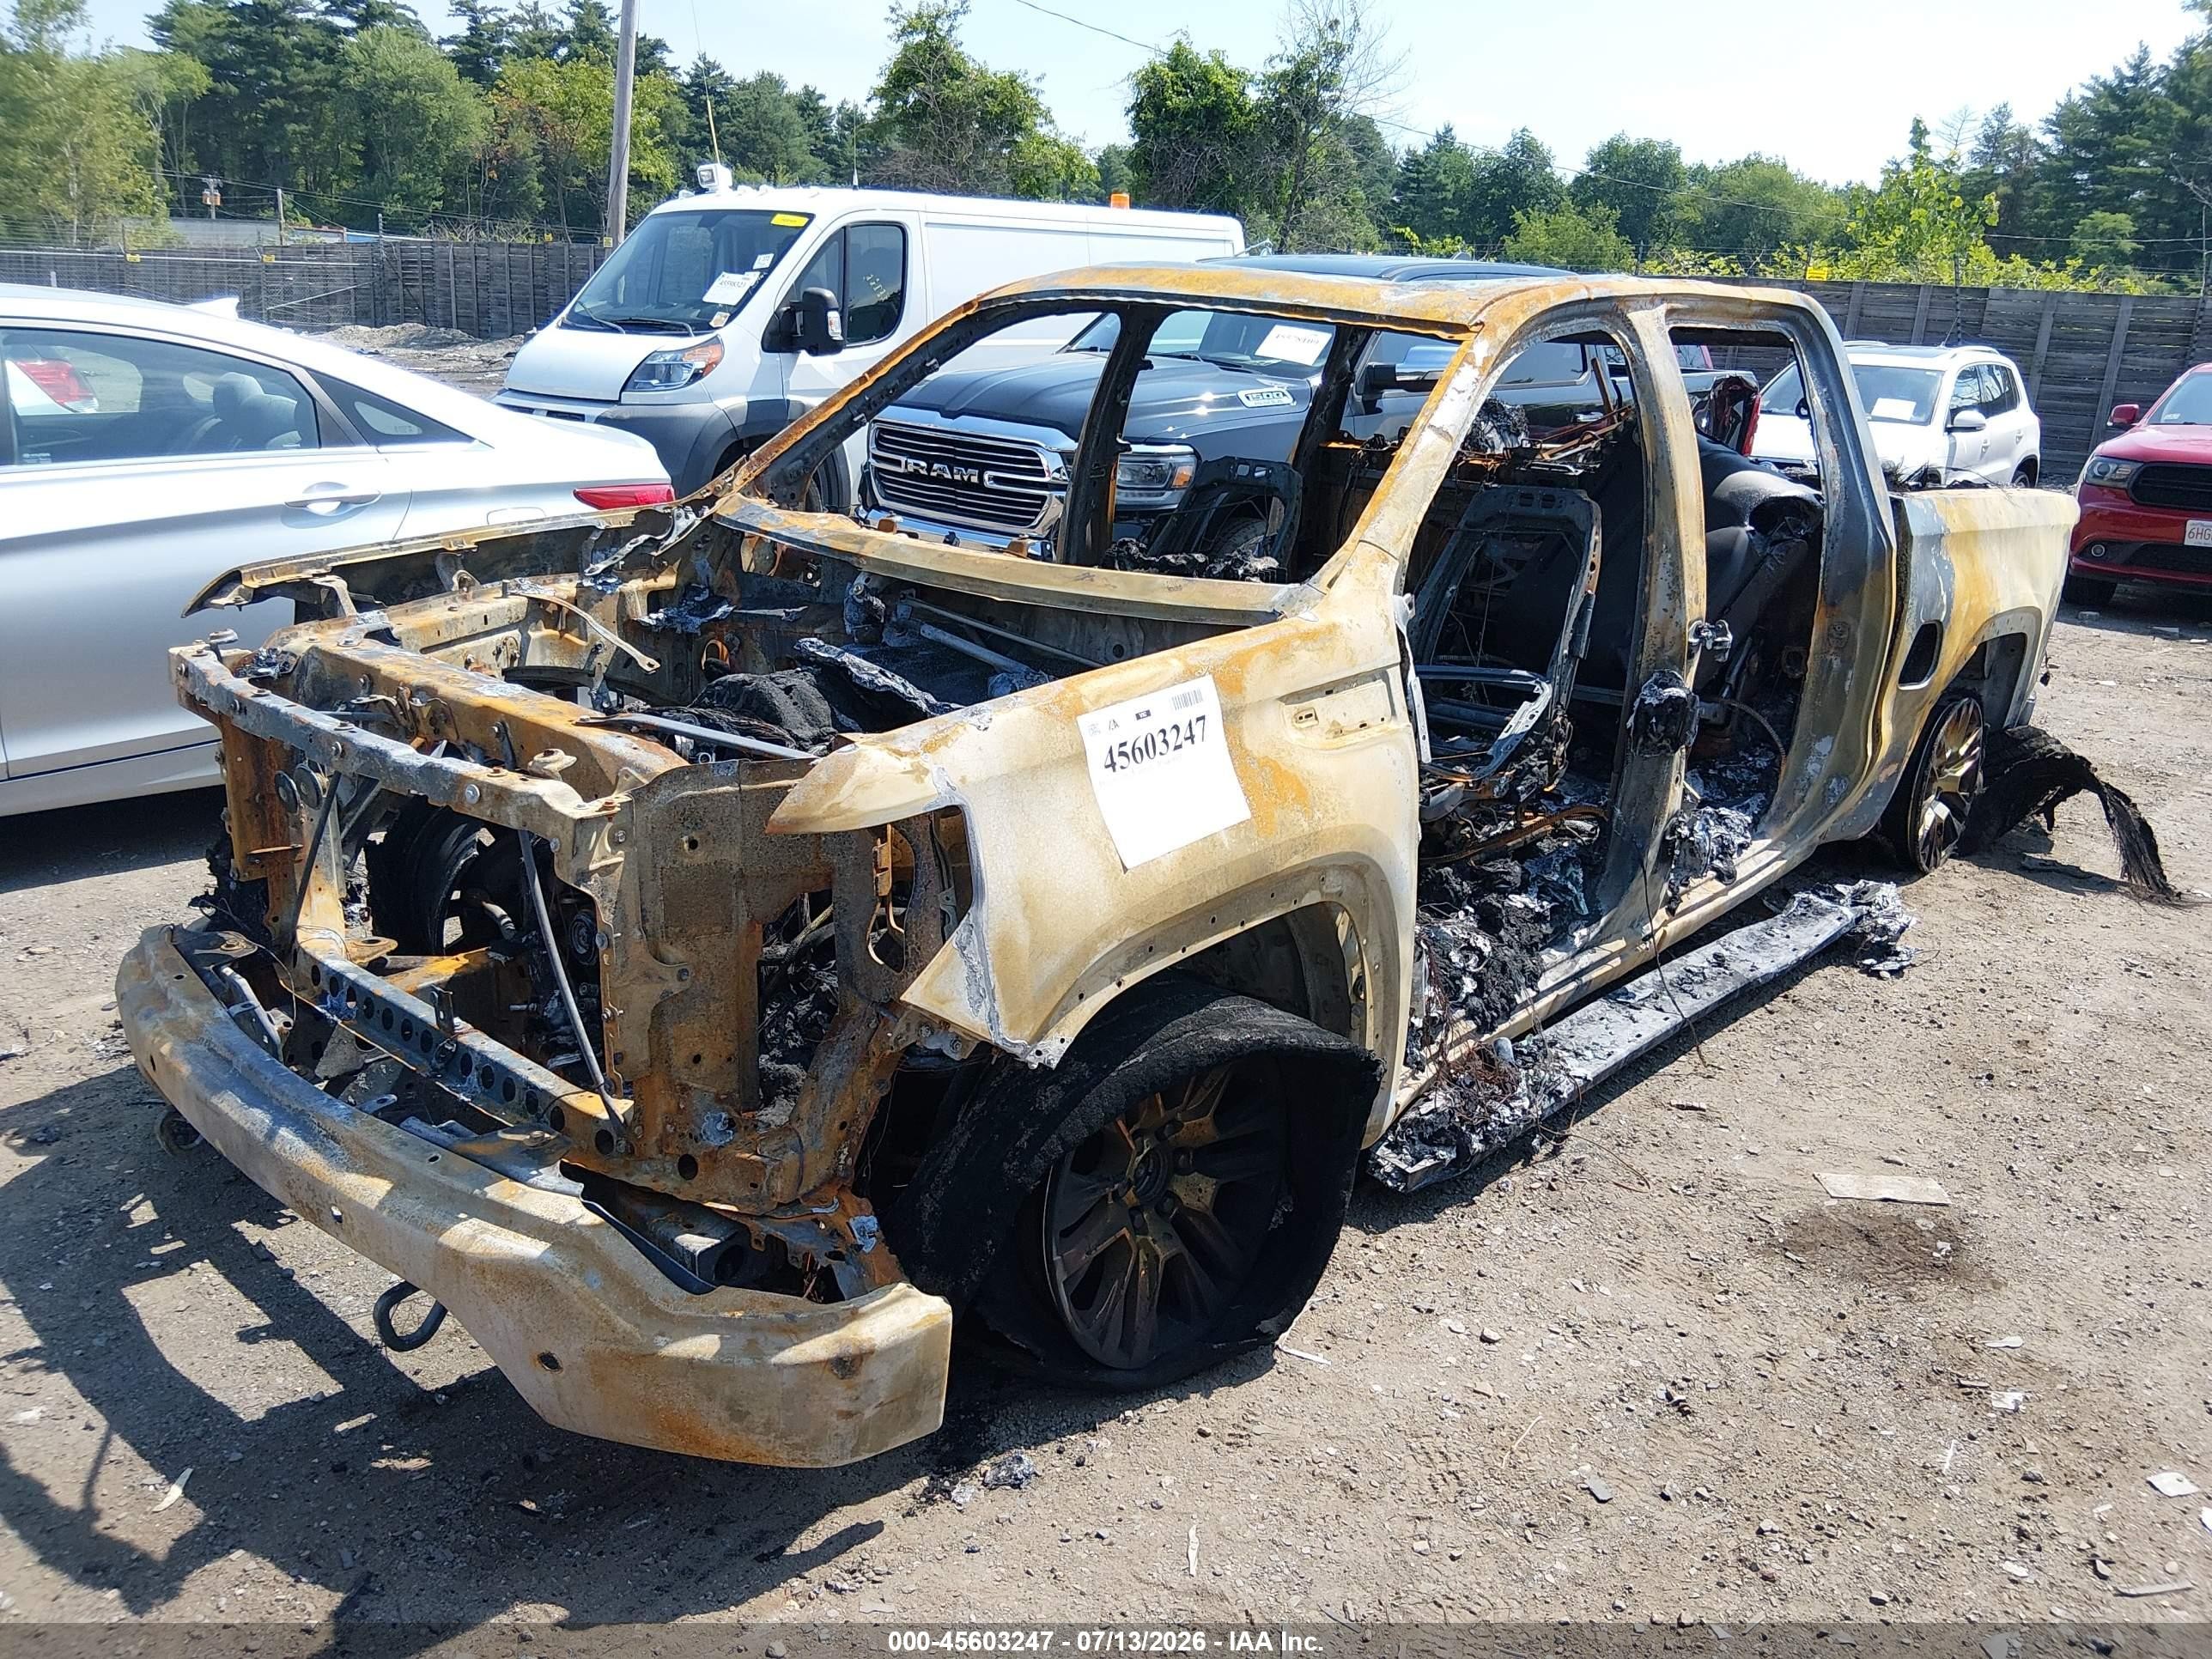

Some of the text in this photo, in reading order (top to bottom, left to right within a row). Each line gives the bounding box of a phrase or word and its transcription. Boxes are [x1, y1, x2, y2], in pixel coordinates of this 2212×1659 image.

[1244, 391, 1284, 401] 1500
[907, 458, 979, 483] RAM
[2187, 526, 2212, 541] 6HG
[1104, 714, 1206, 773] 45603247
